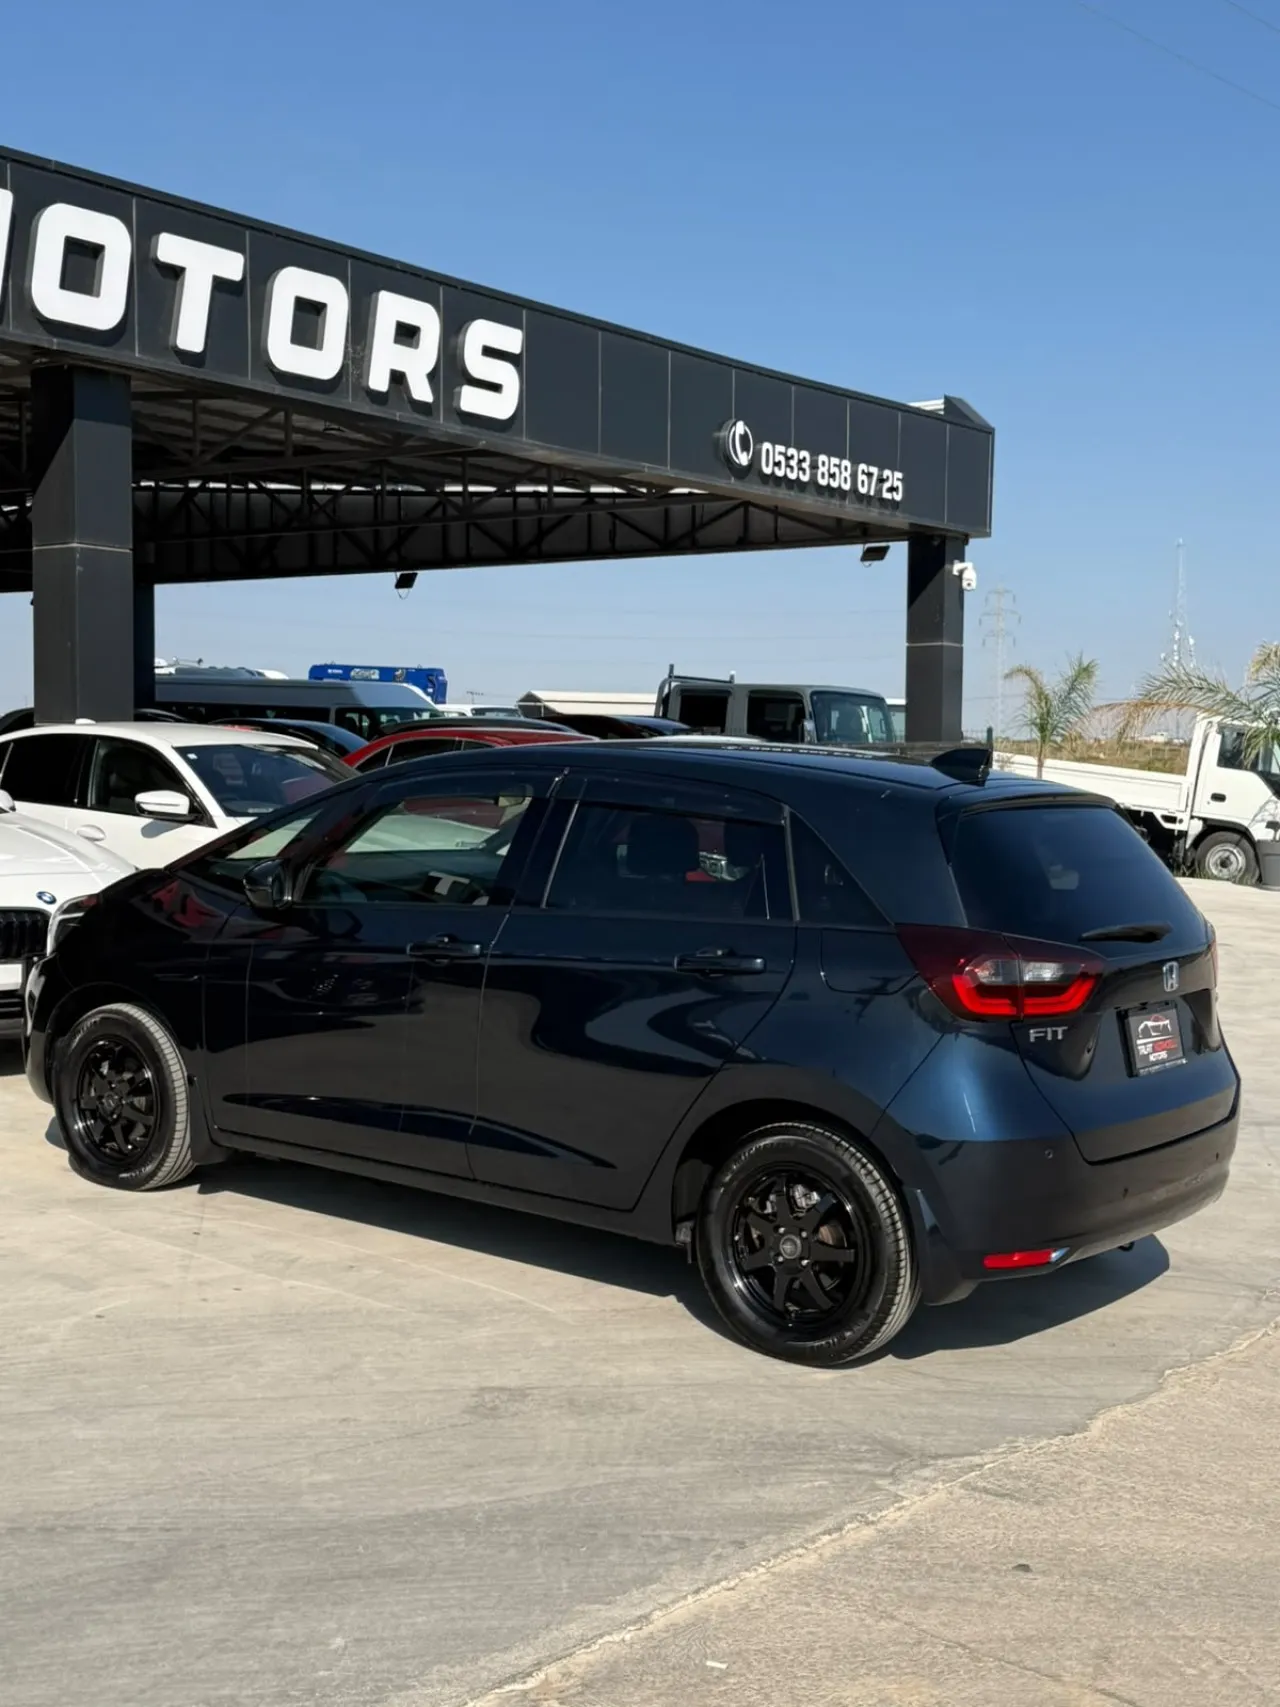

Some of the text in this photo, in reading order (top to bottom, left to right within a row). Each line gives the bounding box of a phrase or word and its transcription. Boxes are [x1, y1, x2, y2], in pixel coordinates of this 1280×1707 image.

[0, 189, 523, 420] OTORS
[761, 441, 903, 501] 0533 858 67 25
[1029, 1026, 1068, 1042] FIT
